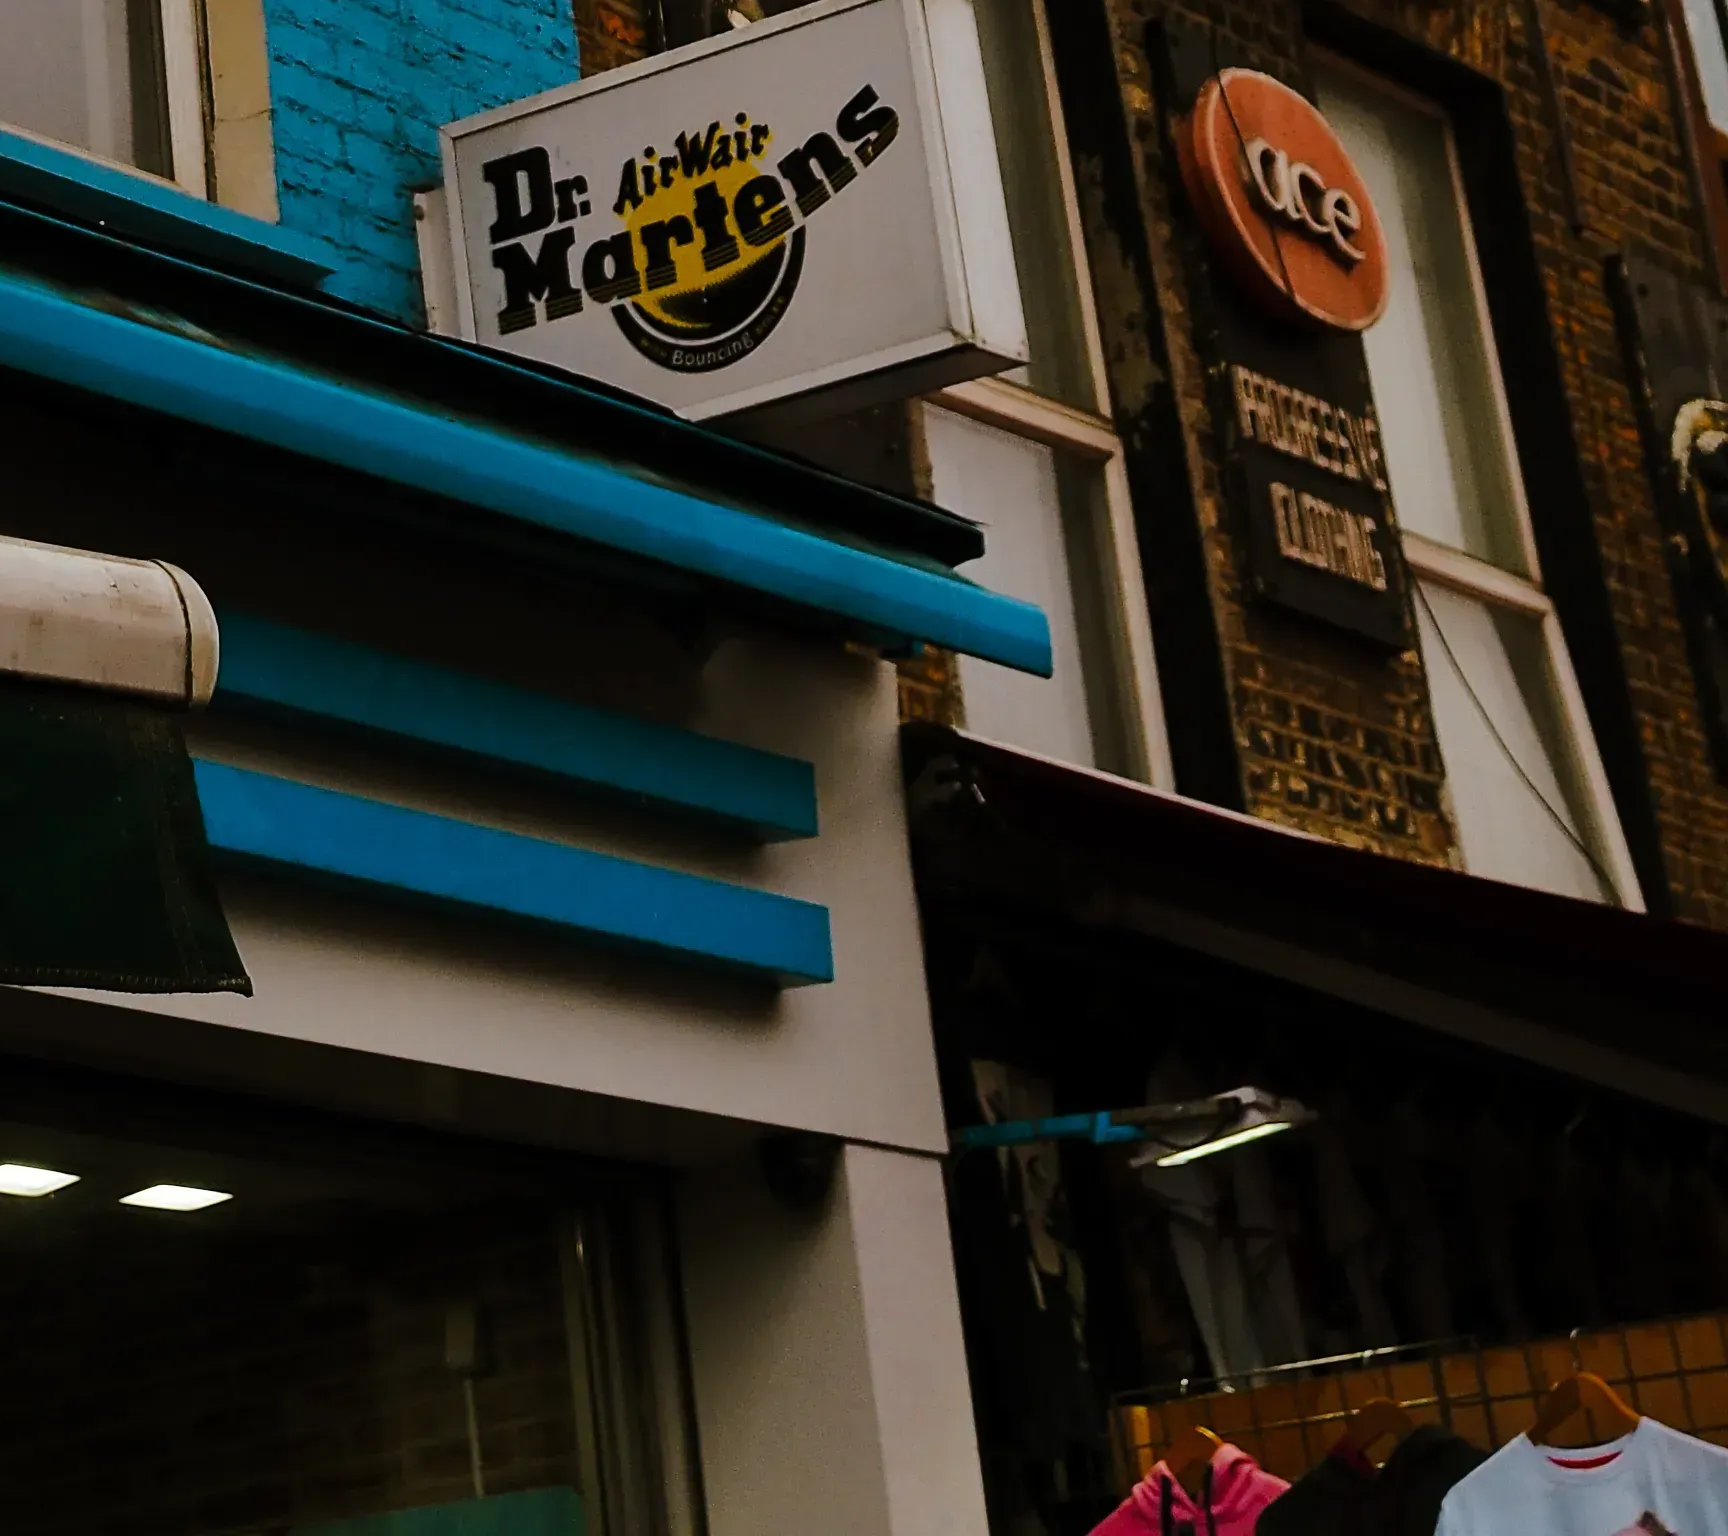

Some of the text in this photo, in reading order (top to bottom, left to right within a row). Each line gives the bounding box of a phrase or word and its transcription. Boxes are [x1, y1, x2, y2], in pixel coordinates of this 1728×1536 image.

[483, 146, 591, 244] Dr.
[492, 83, 900, 336] Martens
[613, 112, 769, 215] AirWair
[1243, 136, 1367, 261] ace
